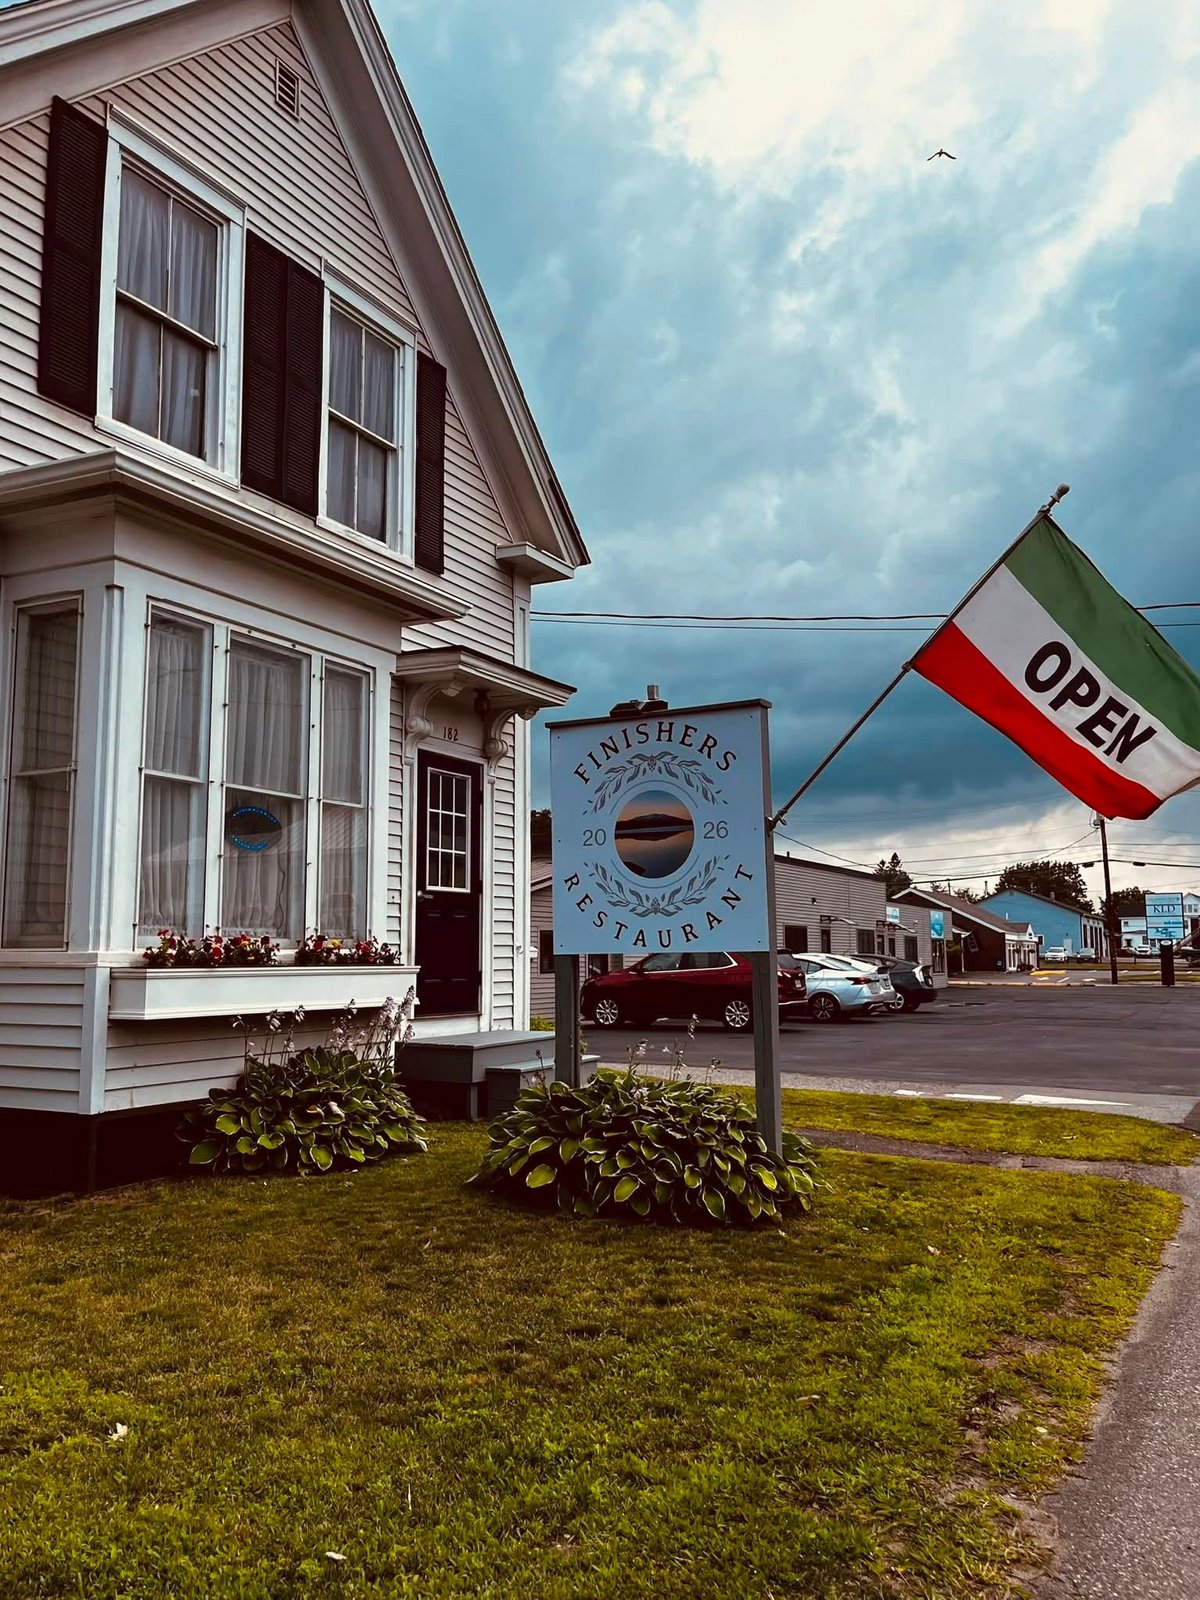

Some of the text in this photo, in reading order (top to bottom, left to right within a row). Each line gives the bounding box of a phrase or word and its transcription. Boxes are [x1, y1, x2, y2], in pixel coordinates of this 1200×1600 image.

[1025, 641, 1157, 764] OPEN
[443, 726, 458, 741] 182
[573, 721, 736, 785] FINISHERS
[582, 828, 606, 846] 20
[703, 820, 729, 839] 26
[563, 863, 753, 948] RESTAURANT
